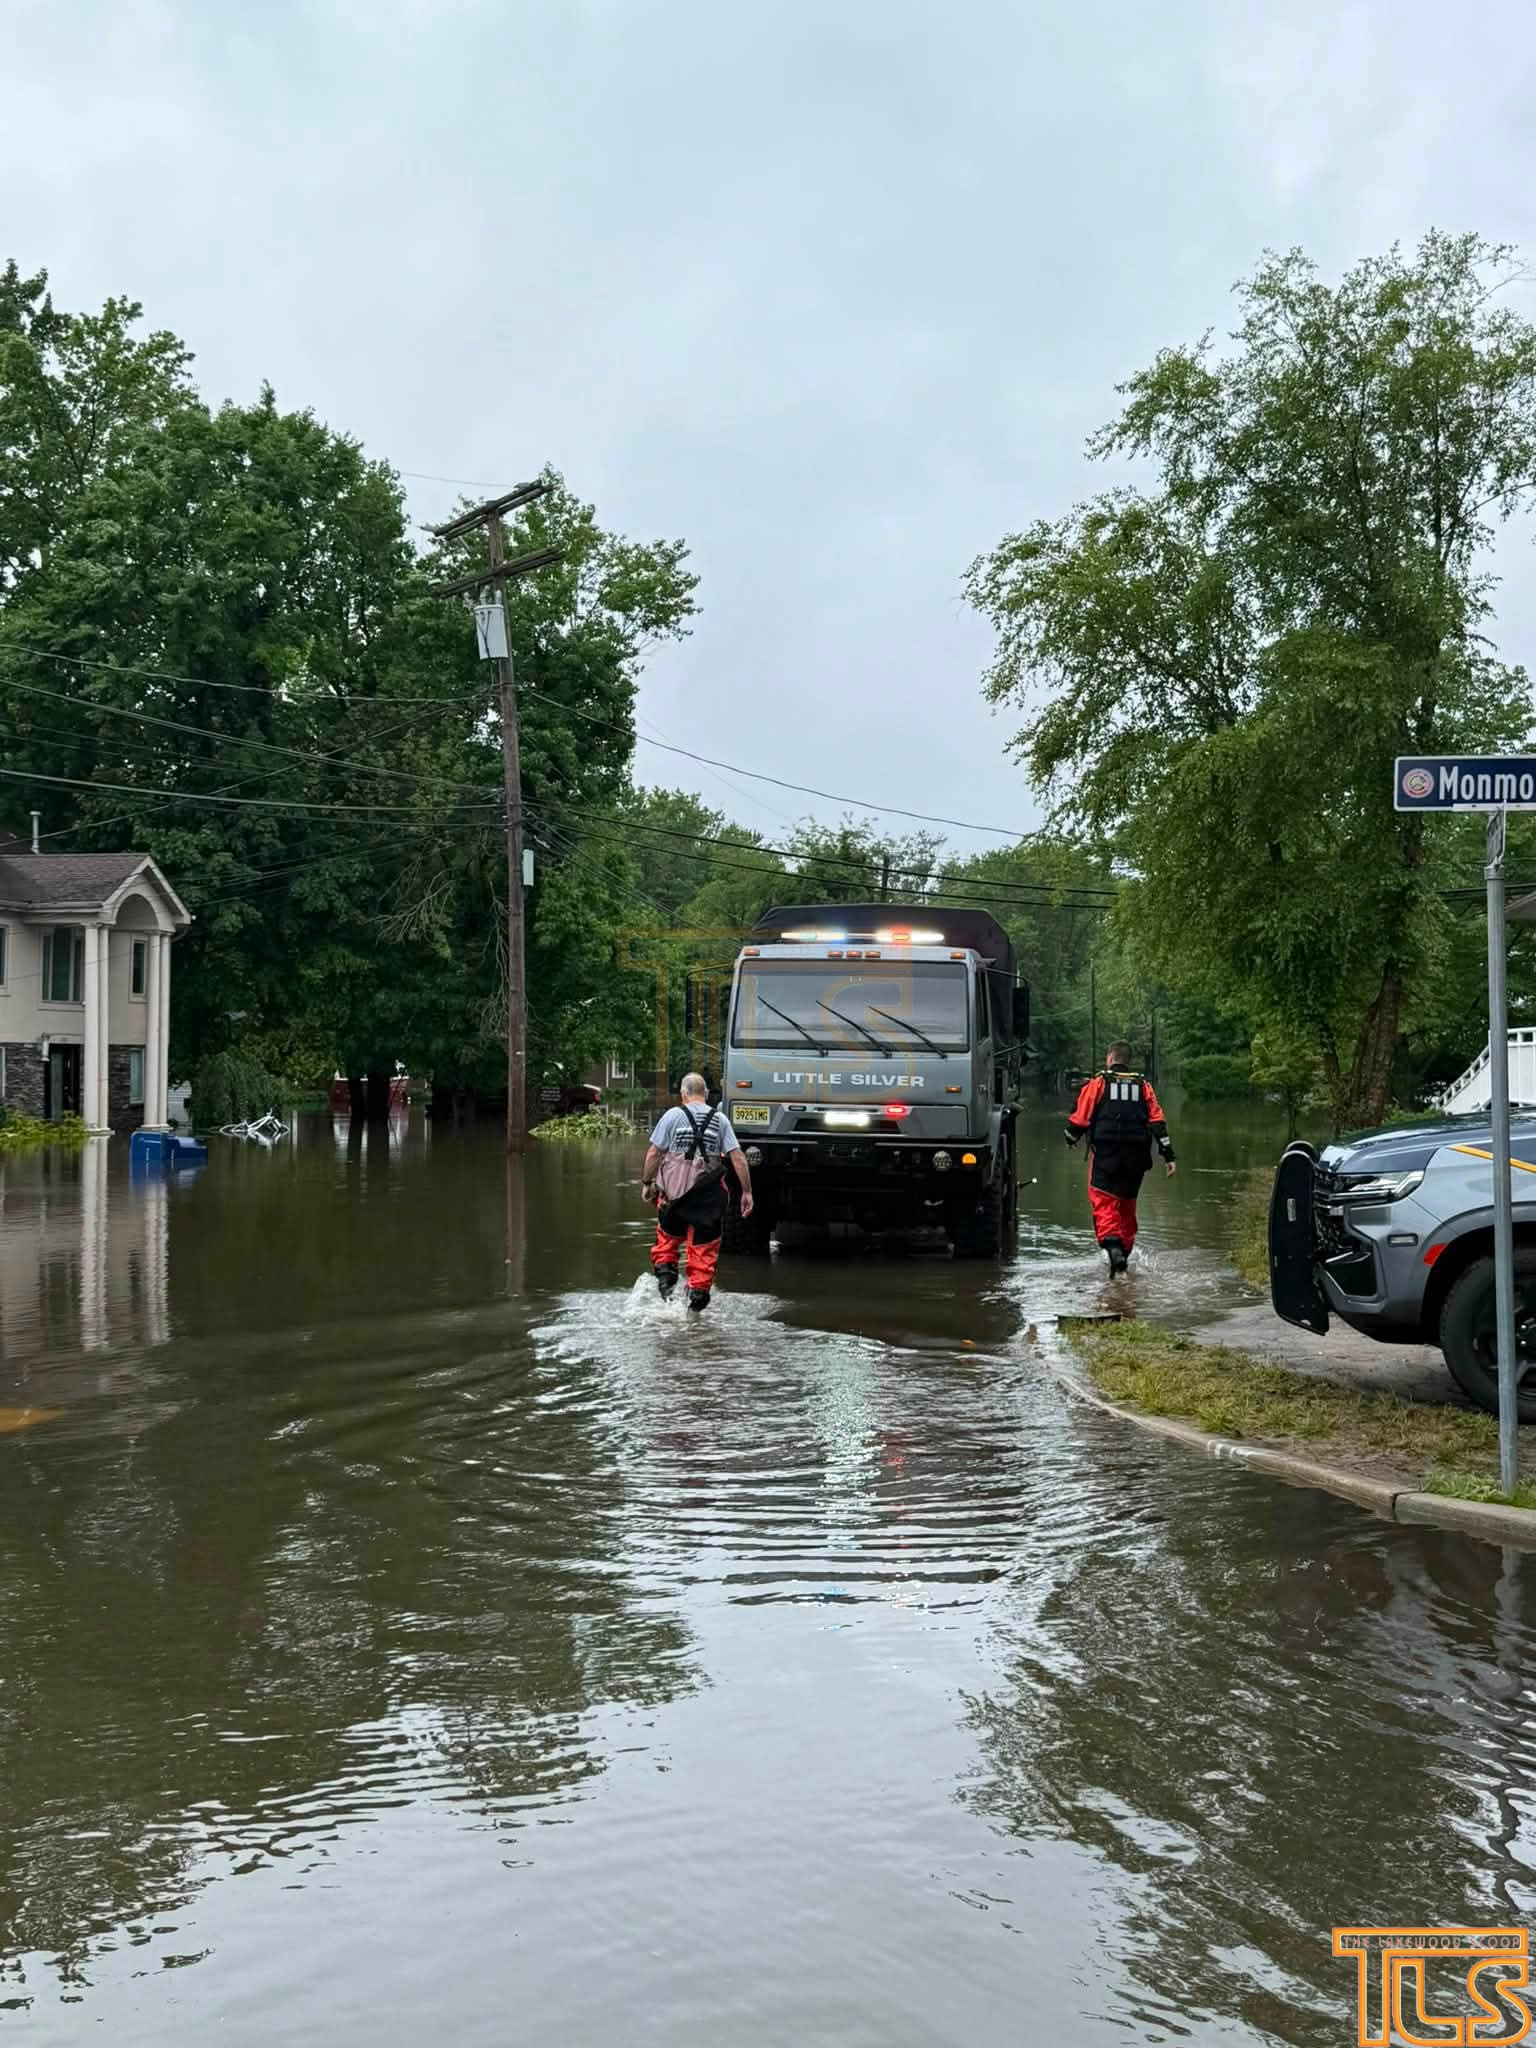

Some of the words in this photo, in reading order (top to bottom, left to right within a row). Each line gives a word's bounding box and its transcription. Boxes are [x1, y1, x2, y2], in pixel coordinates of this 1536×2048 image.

[1439, 765, 1534, 800] Monmo
[773, 1072, 842, 1085] LITTLE
[850, 1074, 925, 1087] SILVER
